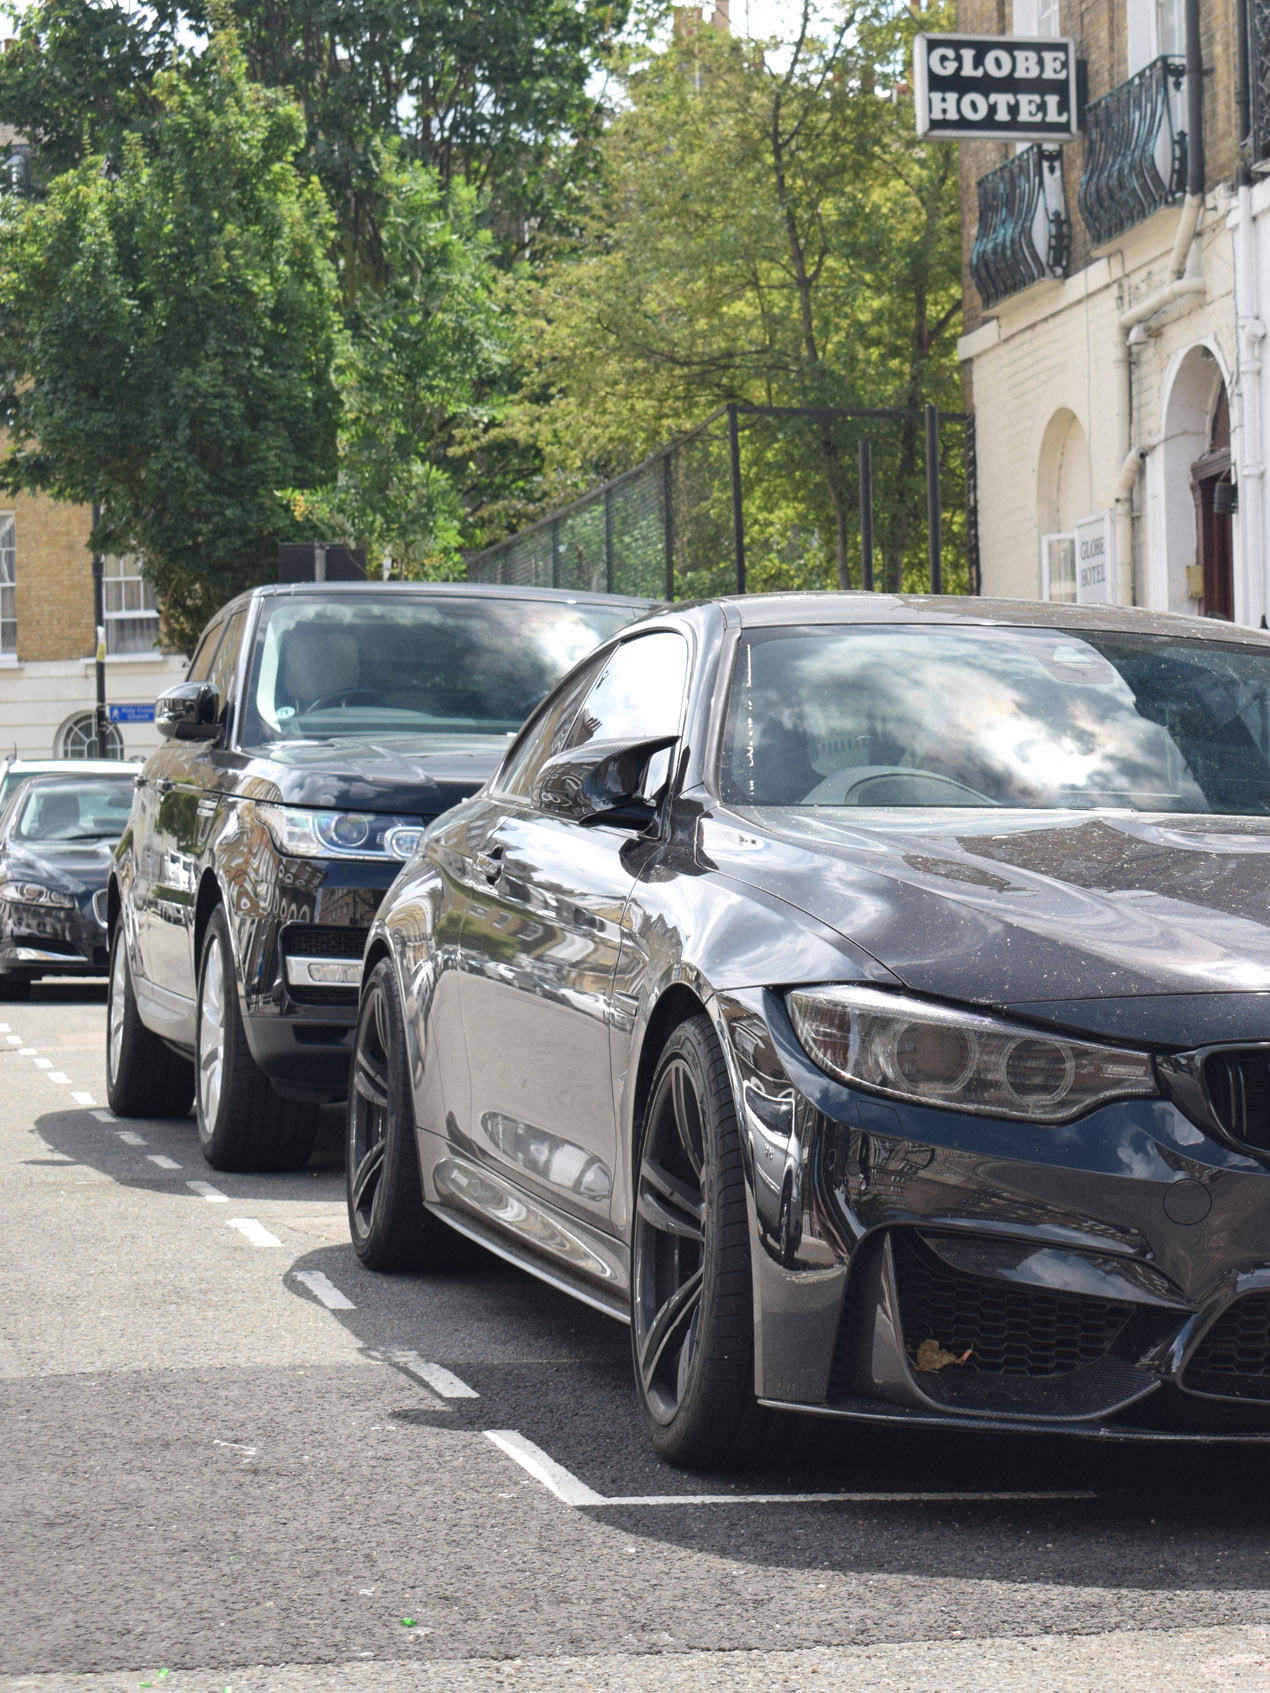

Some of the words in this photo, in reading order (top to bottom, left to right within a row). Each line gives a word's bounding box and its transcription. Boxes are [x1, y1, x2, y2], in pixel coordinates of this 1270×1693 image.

[928, 47, 1067, 80] GLOBE
[929, 91, 1068, 123] HOTEL
[1080, 536, 1105, 560] GLOBE
[1080, 563, 1106, 588] HOTEL
